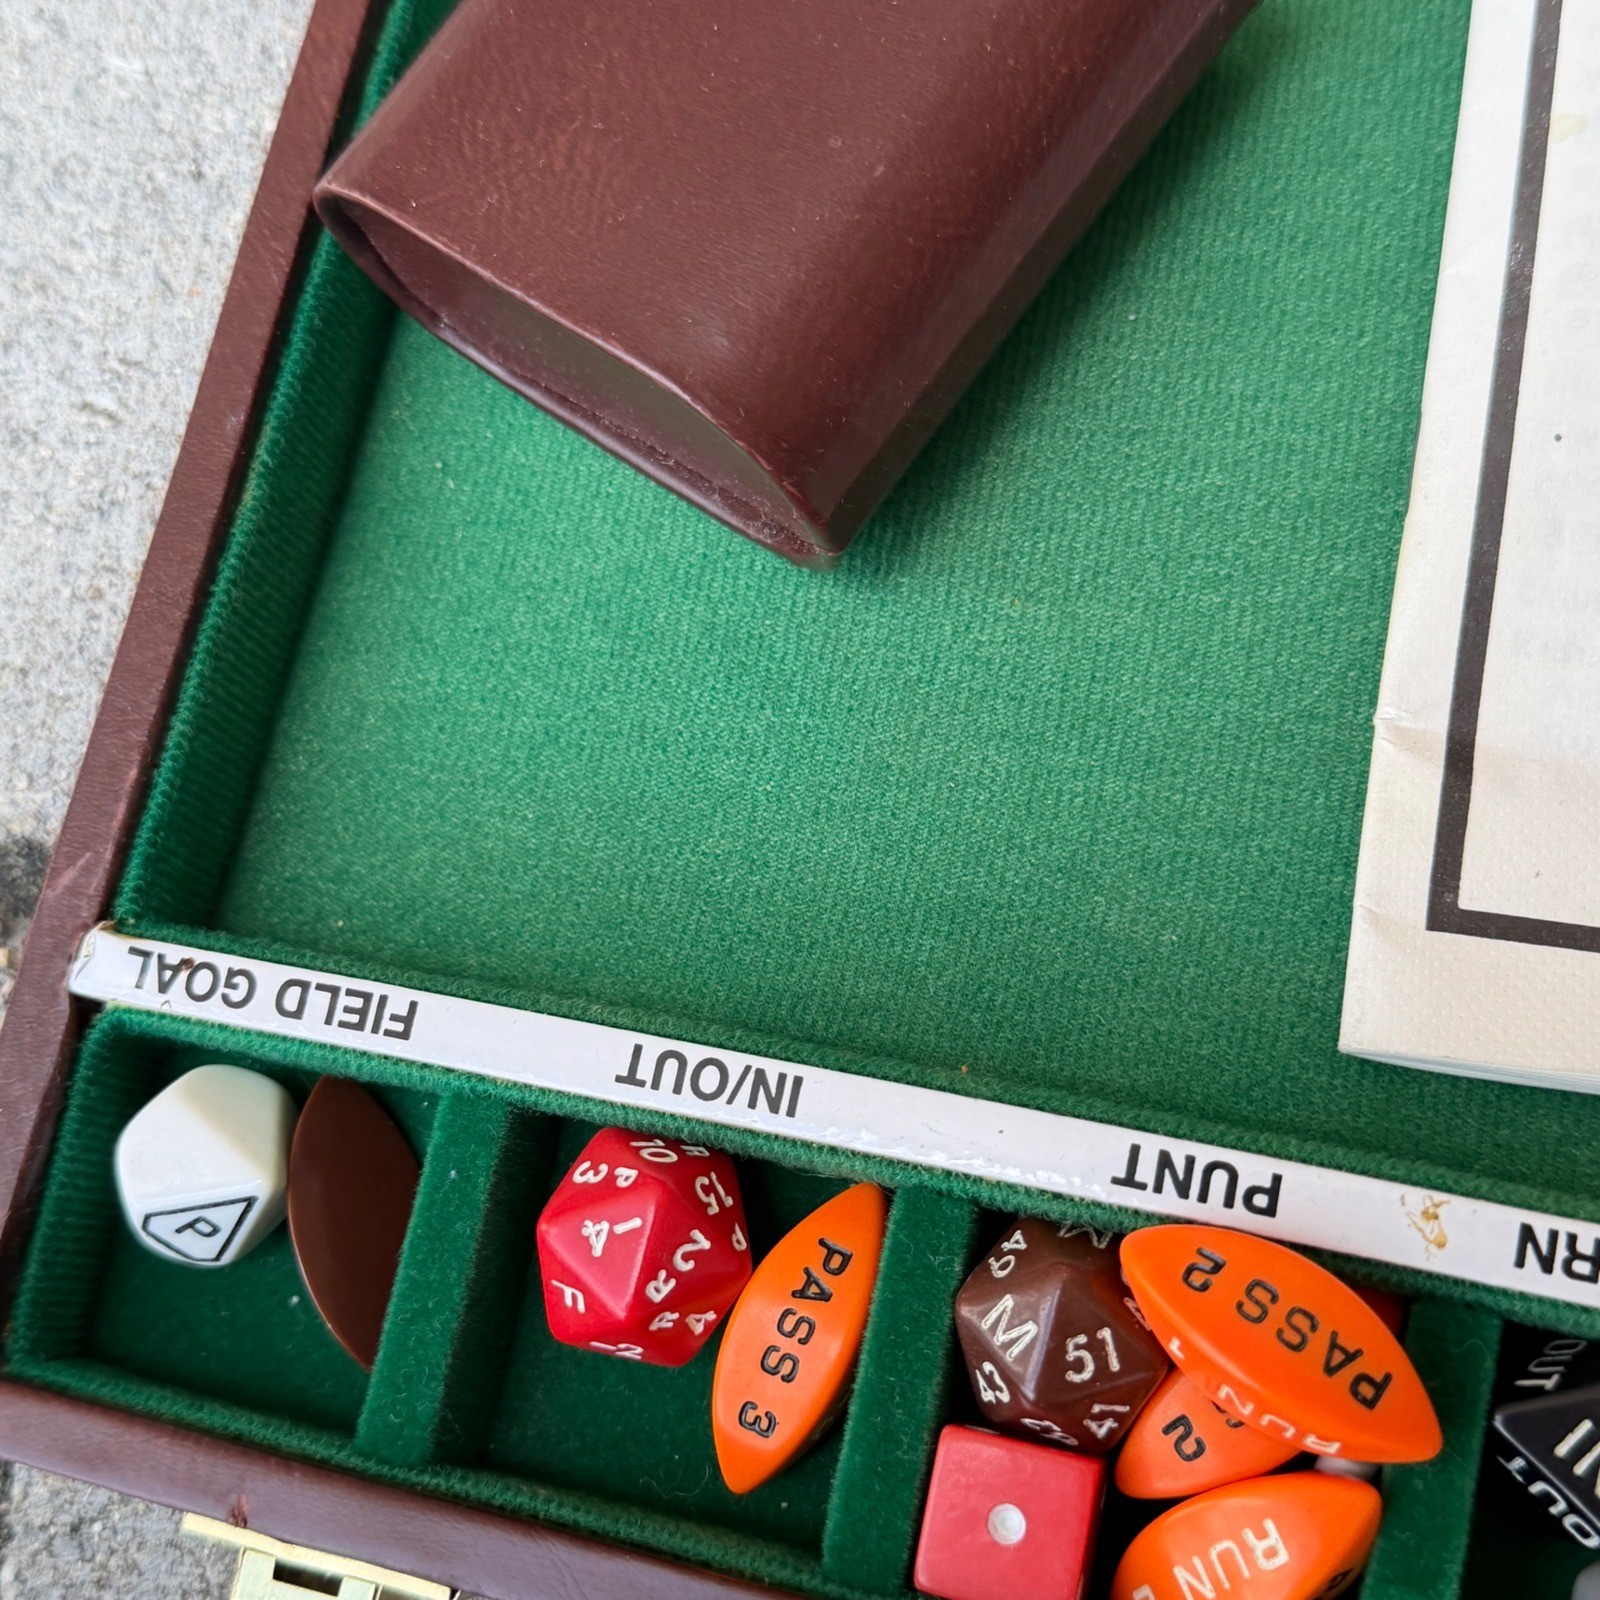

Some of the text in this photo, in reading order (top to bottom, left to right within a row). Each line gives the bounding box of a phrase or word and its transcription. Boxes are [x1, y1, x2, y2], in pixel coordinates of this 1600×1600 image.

[127, 945, 419, 1041] FIELD GOAL
[614, 1043, 804, 1118] IN/OUT
[572, 1160, 609, 1184] 3
[695, 1171, 734, 1216] 15
[1110, 1143, 1283, 1218] PUNT
[174, 1215, 222, 1238] P
[551, 1279, 586, 1314] F
[645, 1228, 711, 1303] R 2
[738, 1237, 854, 1439] PASS 3
[981, 1293, 1039, 1362] M
[1064, 1326, 1121, 1383] 51
[1181, 1247, 1393, 1411] PASS 2
[1513, 1340, 1589, 1391] OUT
[1161, 1413, 1207, 1462] 2
[1218, 1384, 1342, 1454] RUN
[1172, 1517, 1290, 1600] RUN
